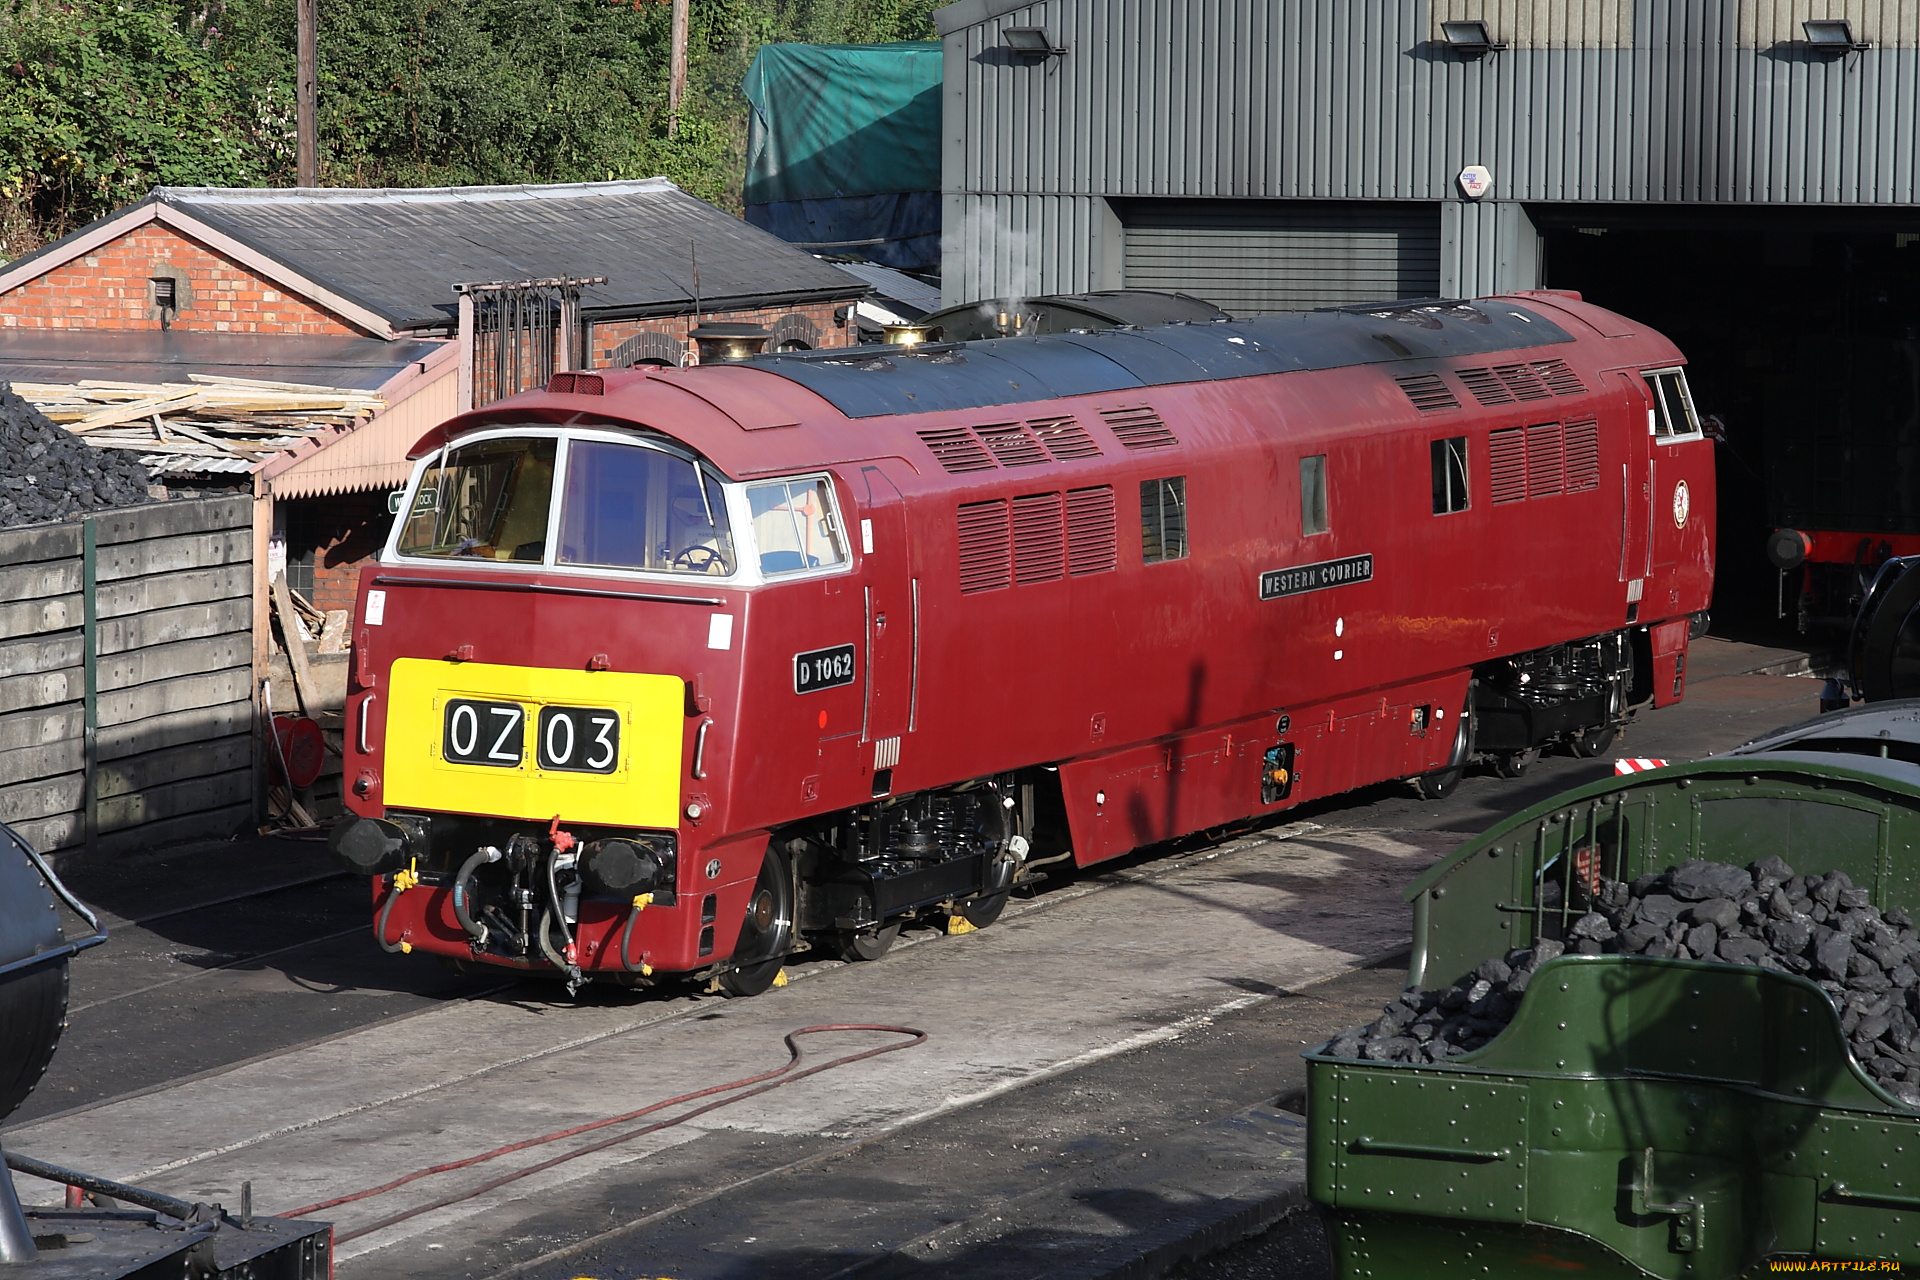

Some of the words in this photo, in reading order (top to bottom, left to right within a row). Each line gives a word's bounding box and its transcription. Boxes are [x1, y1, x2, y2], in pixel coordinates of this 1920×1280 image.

[1265, 570, 1316, 594] WESTERN
[1322, 560, 1370, 583] COURIER
[800, 662, 810, 685] D
[816, 653, 851, 682] 1062
[546, 713, 615, 769] 03
